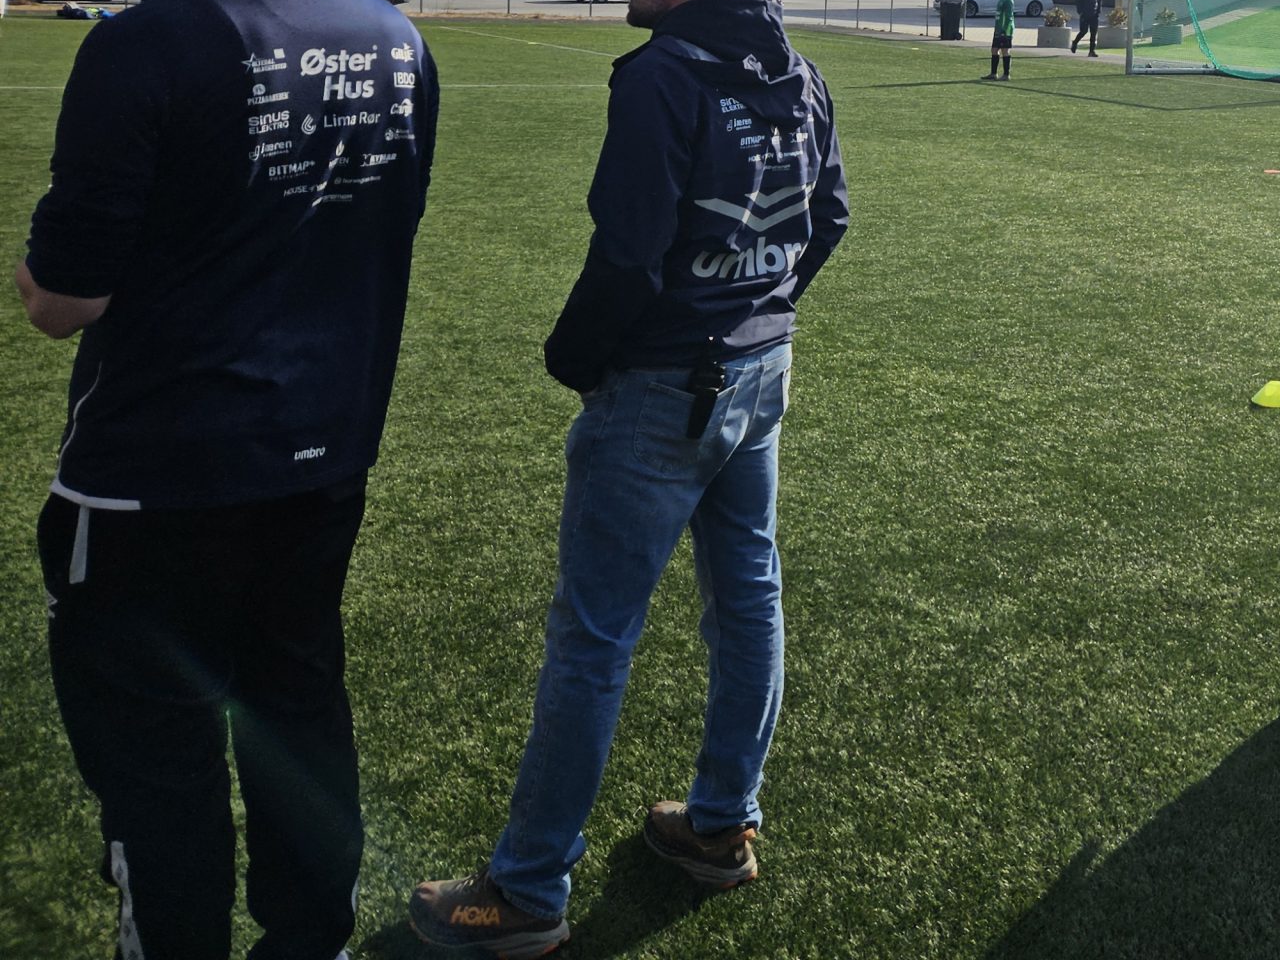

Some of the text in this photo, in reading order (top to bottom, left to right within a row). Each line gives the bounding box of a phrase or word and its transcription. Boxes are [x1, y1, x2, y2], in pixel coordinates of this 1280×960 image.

[300, 48, 377, 77] Øster
[322, 74, 375, 101] Hus
[397, 73, 415, 86] BDO
[720, 97, 740, 107] Sin
[722, 103, 747, 113] ELEKTR
[324, 111, 380, 128] Lima Rør
[249, 121, 290, 135] ELEKTRO
[691, 236, 802, 280] umbr
[294, 446, 326, 461] umbro
[451, 904, 500, 927] HOKA
